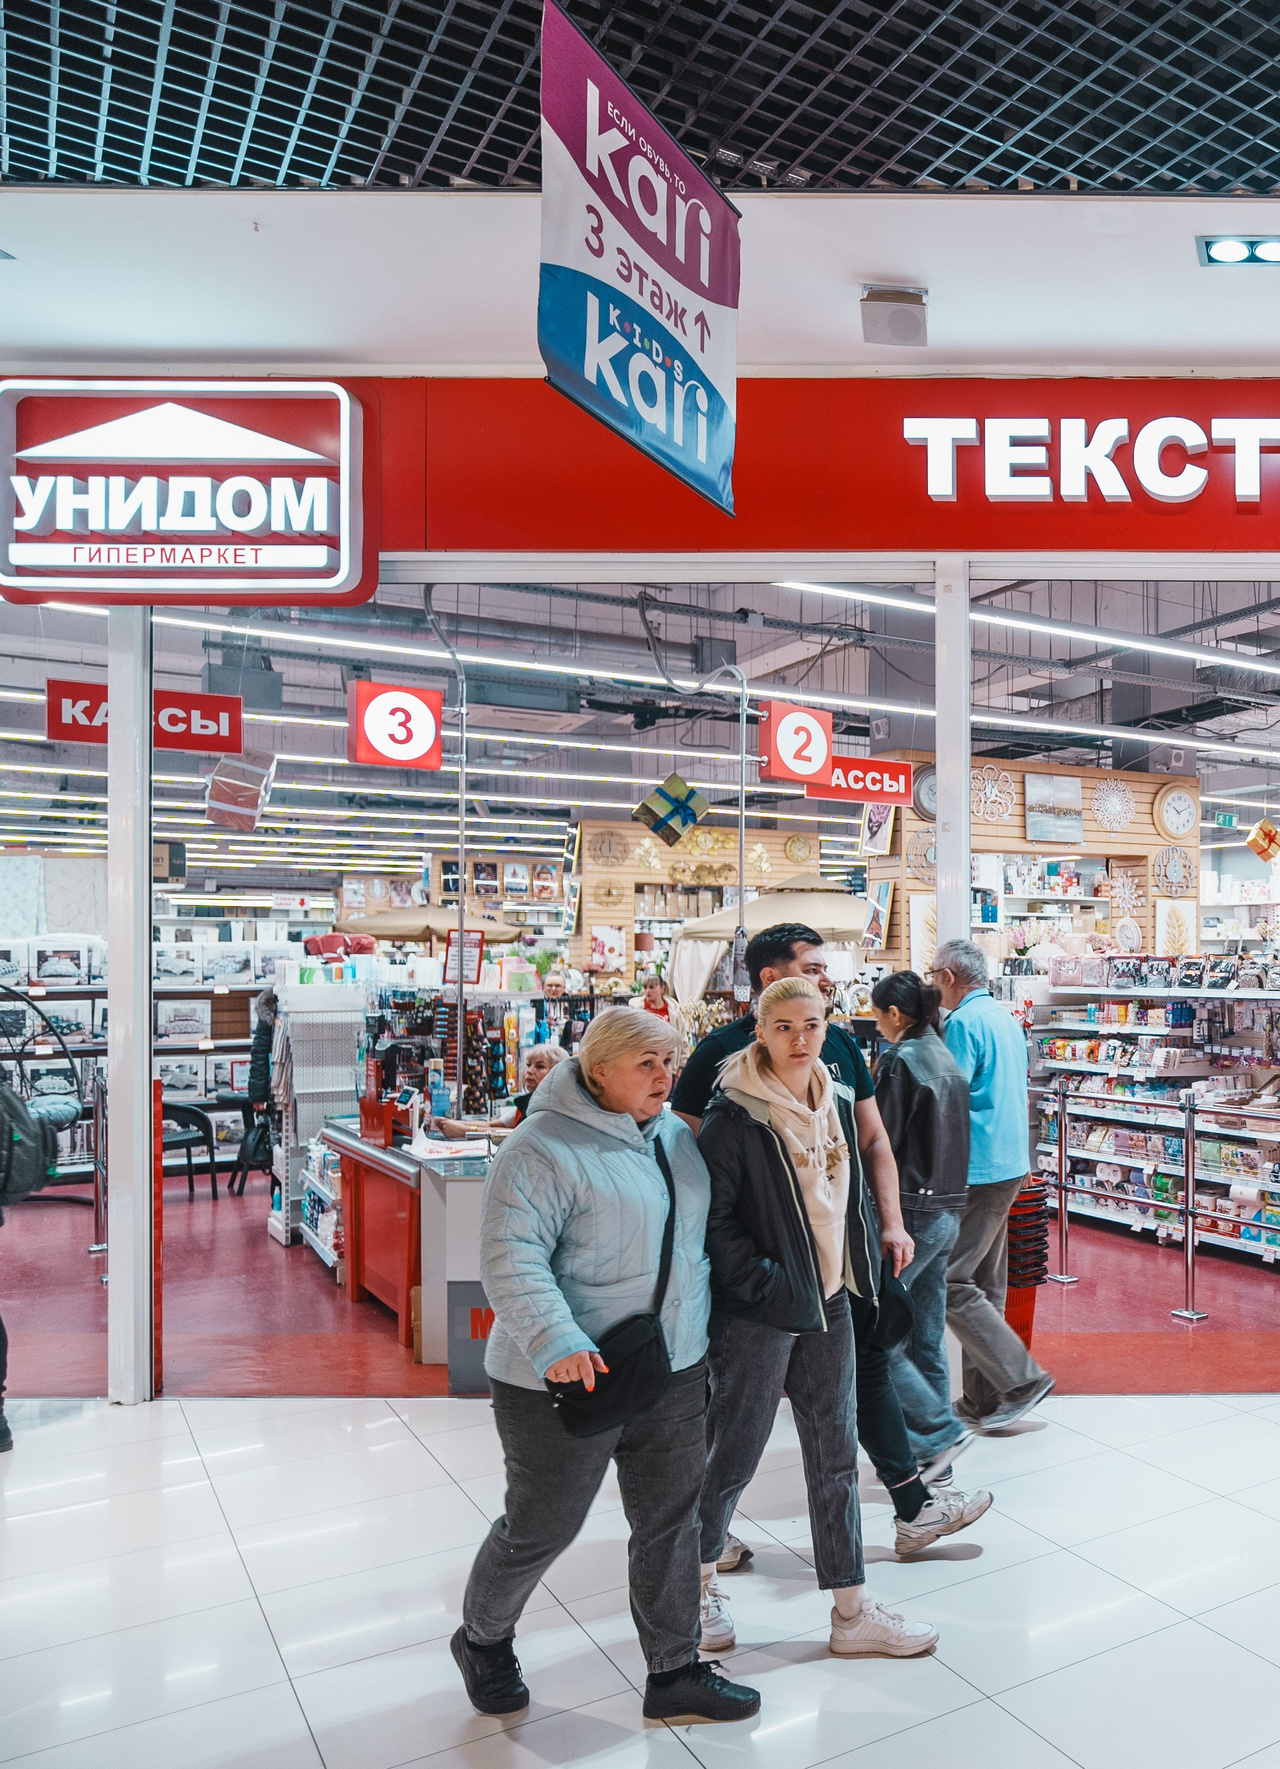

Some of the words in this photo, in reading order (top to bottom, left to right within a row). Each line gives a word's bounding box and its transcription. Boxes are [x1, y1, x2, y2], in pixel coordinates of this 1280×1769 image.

[607, 100, 636, 141] ЕСЛИ
[674, 173, 686, 195] ТО
[586, 78, 712, 288] kari
[584, 204, 604, 259] 3
[615, 246, 688, 336] этаж
[584, 291, 708, 464] kari
[11, 476, 329, 533] УНИДОМ
[72, 545, 264, 566] ГИПЕРМАРКЕТ
[62, 698, 230, 737] КАСЫ
[387, 707, 414, 744] 3
[793, 726, 812, 762] 2
